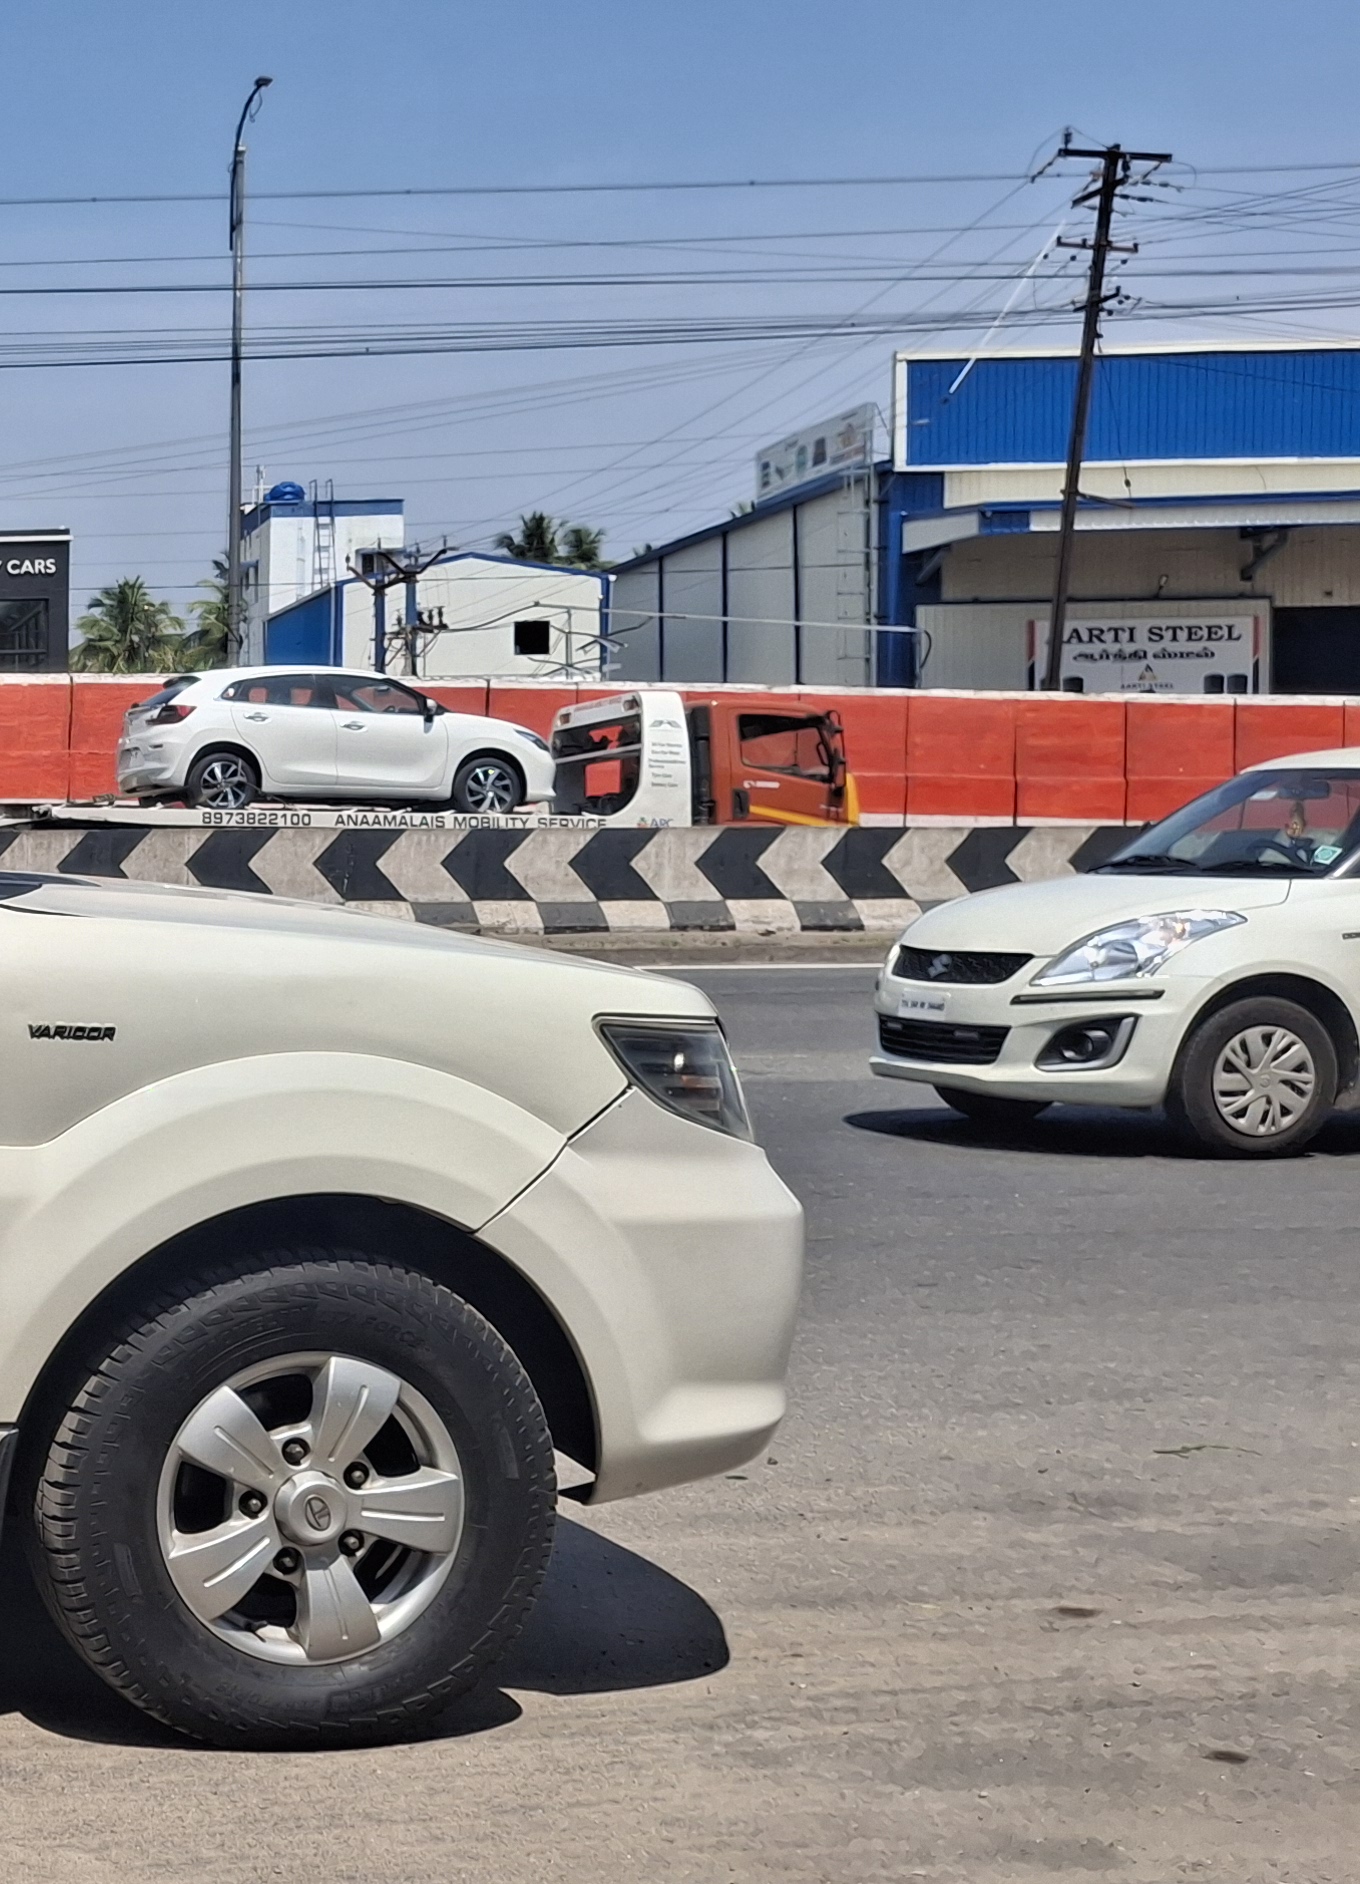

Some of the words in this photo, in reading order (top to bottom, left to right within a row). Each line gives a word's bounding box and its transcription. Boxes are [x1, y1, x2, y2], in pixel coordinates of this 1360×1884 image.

[6, 559, 57, 575] CARS
[1047, 626, 1137, 644] ARTI
[1147, 624, 1242, 643] STEEL
[201, 812, 312, 826] 8973822100
[334, 813, 446, 828] ANAAMALAIS
[453, 816, 531, 829] MOBILITY
[536, 818, 607, 829] SERVICE
